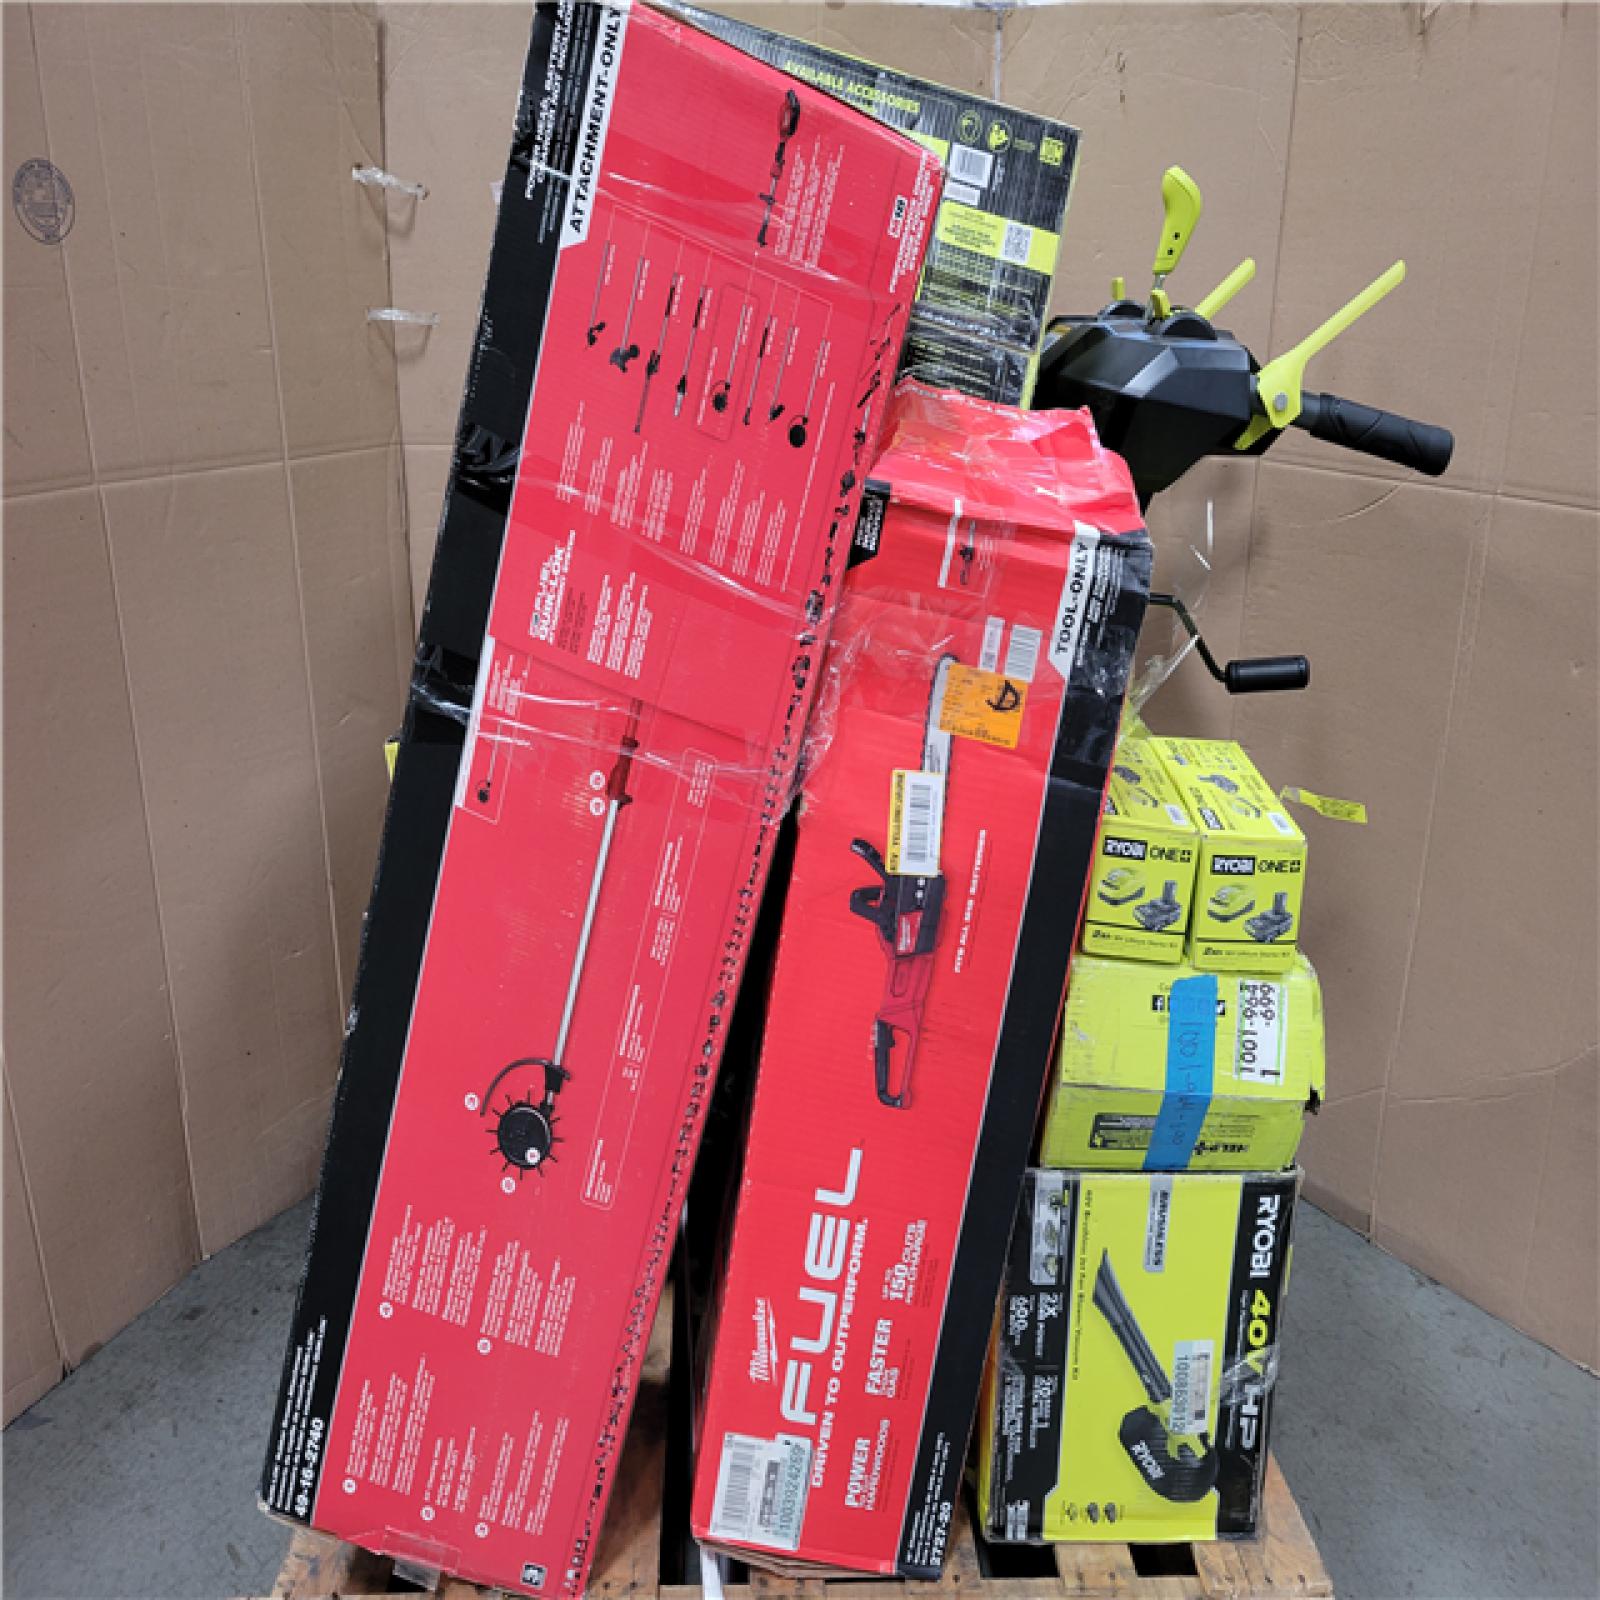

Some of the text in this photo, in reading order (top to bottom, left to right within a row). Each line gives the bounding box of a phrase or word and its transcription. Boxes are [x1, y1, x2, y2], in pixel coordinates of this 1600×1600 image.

[569, 7, 622, 234] ATTACHMENT-ONLY
[1055, 541, 1090, 655] TOOL-ONLY
[1104, 838, 1146, 860] RYOBI
[1213, 856, 1255, 875] RYOBI
[1248, 1194, 1280, 1279] RYOBI
[780, 1147, 863, 1425] FUEL
[889, 1263, 909, 1301] 150
[864, 1318, 893, 1395] FASTER
[812, 1410, 836, 1488] DRIVEN
[824, 1378, 841, 1406] TO
[844, 1437, 871, 1508] POWER
